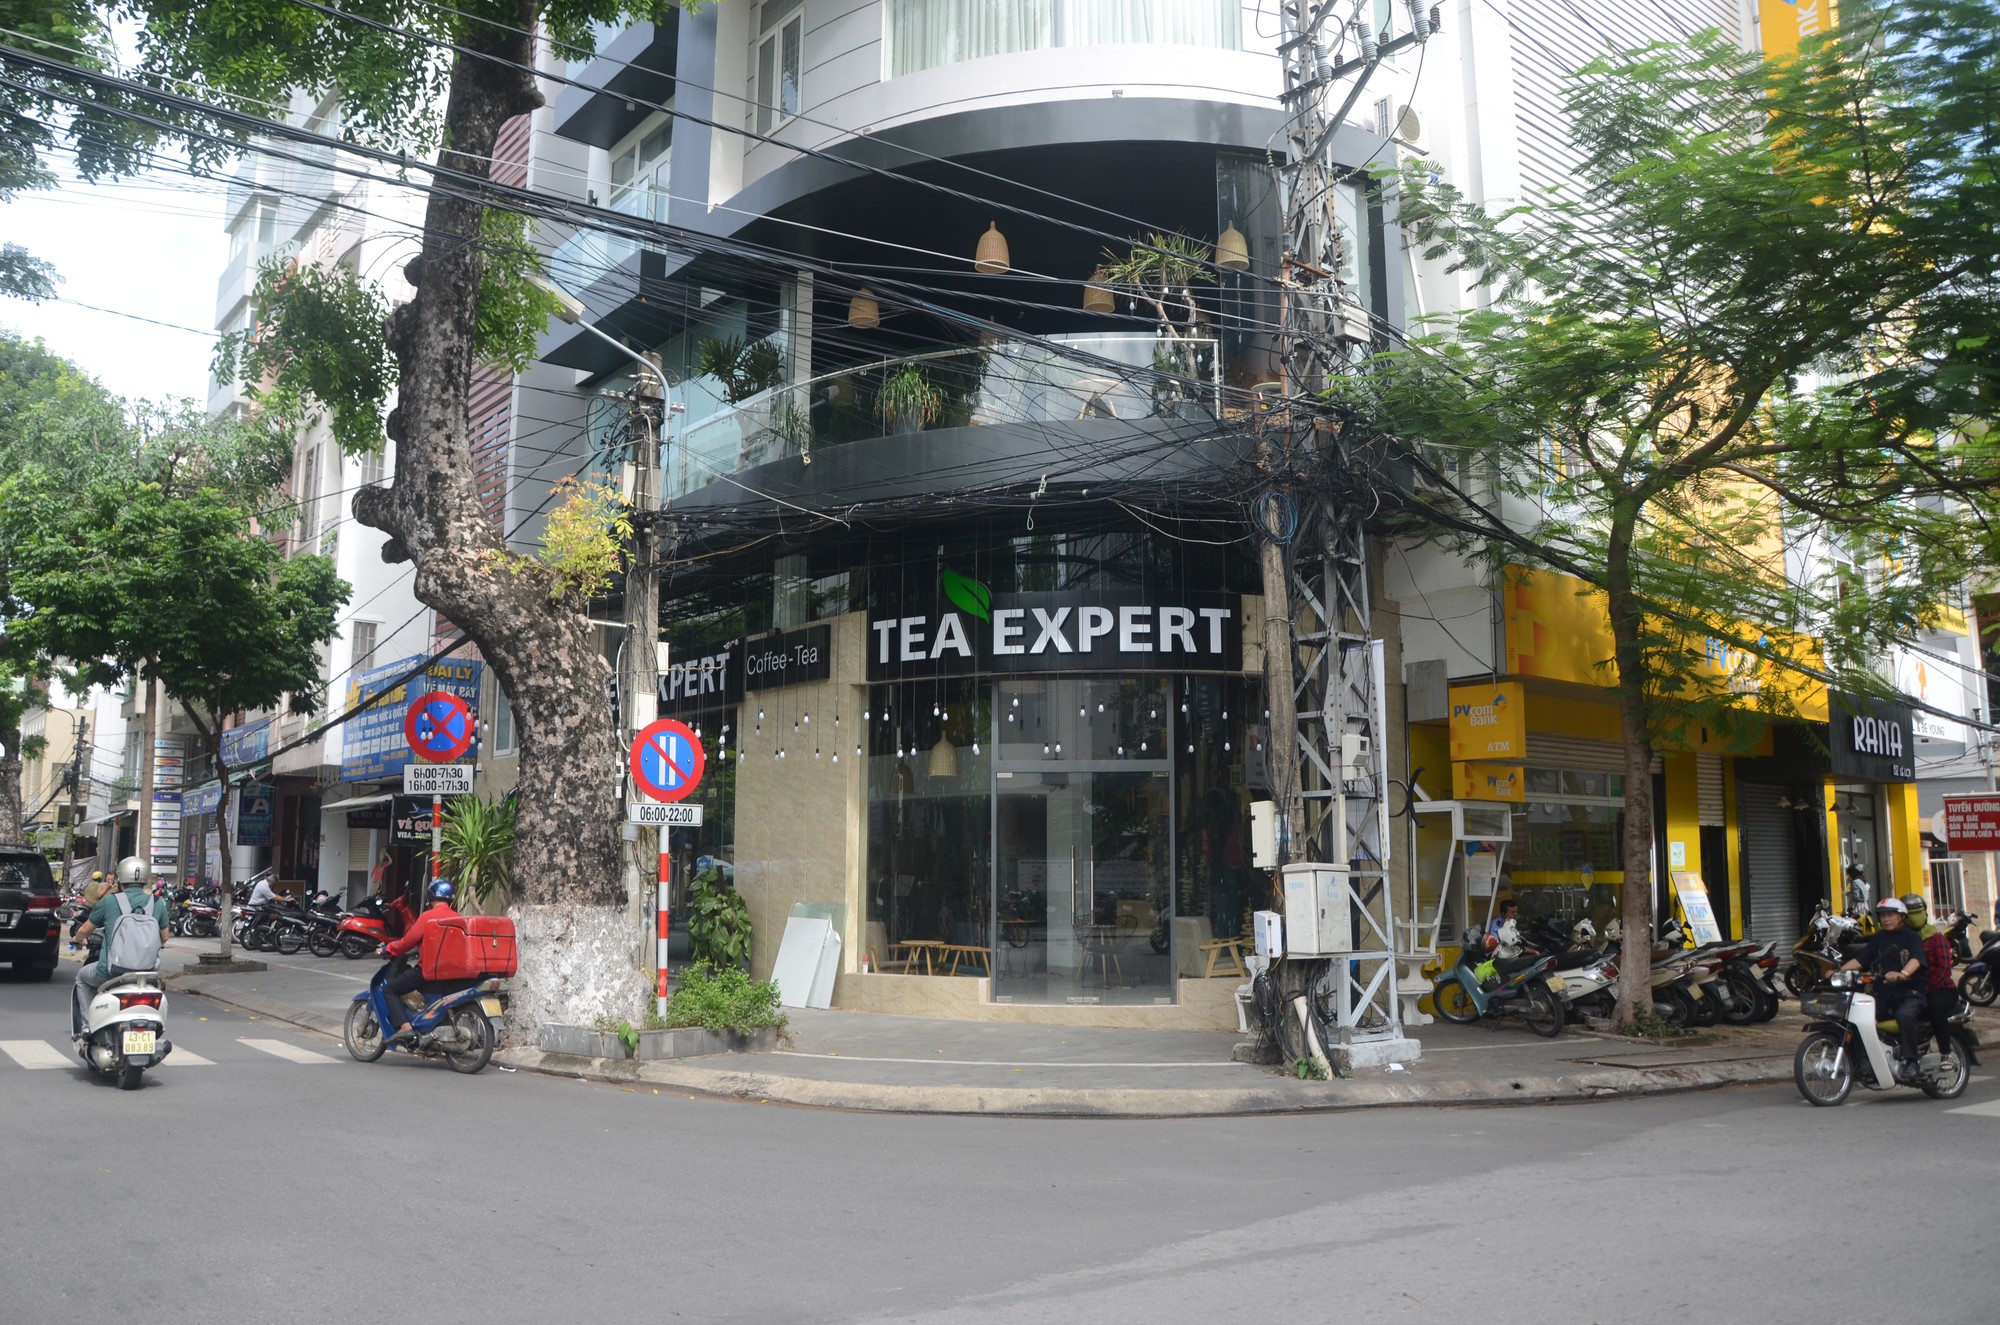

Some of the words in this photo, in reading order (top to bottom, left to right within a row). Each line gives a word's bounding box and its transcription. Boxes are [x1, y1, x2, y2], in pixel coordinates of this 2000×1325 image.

[872, 612, 972, 664] TEA
[993, 606, 1231, 655] EXPERT
[657, 652, 730, 702] XPERT
[1454, 704, 1494, 718] PVcom
[1470, 714, 1498, 726] Bank
[1853, 715, 1903, 757] RANA
[1487, 741, 1510, 752] ATM
[413, 767, 463, 779] 6h00-7h30
[408, 780, 469, 792] 16h00-17h30
[639, 806, 693, 822] 06:00-22:00
